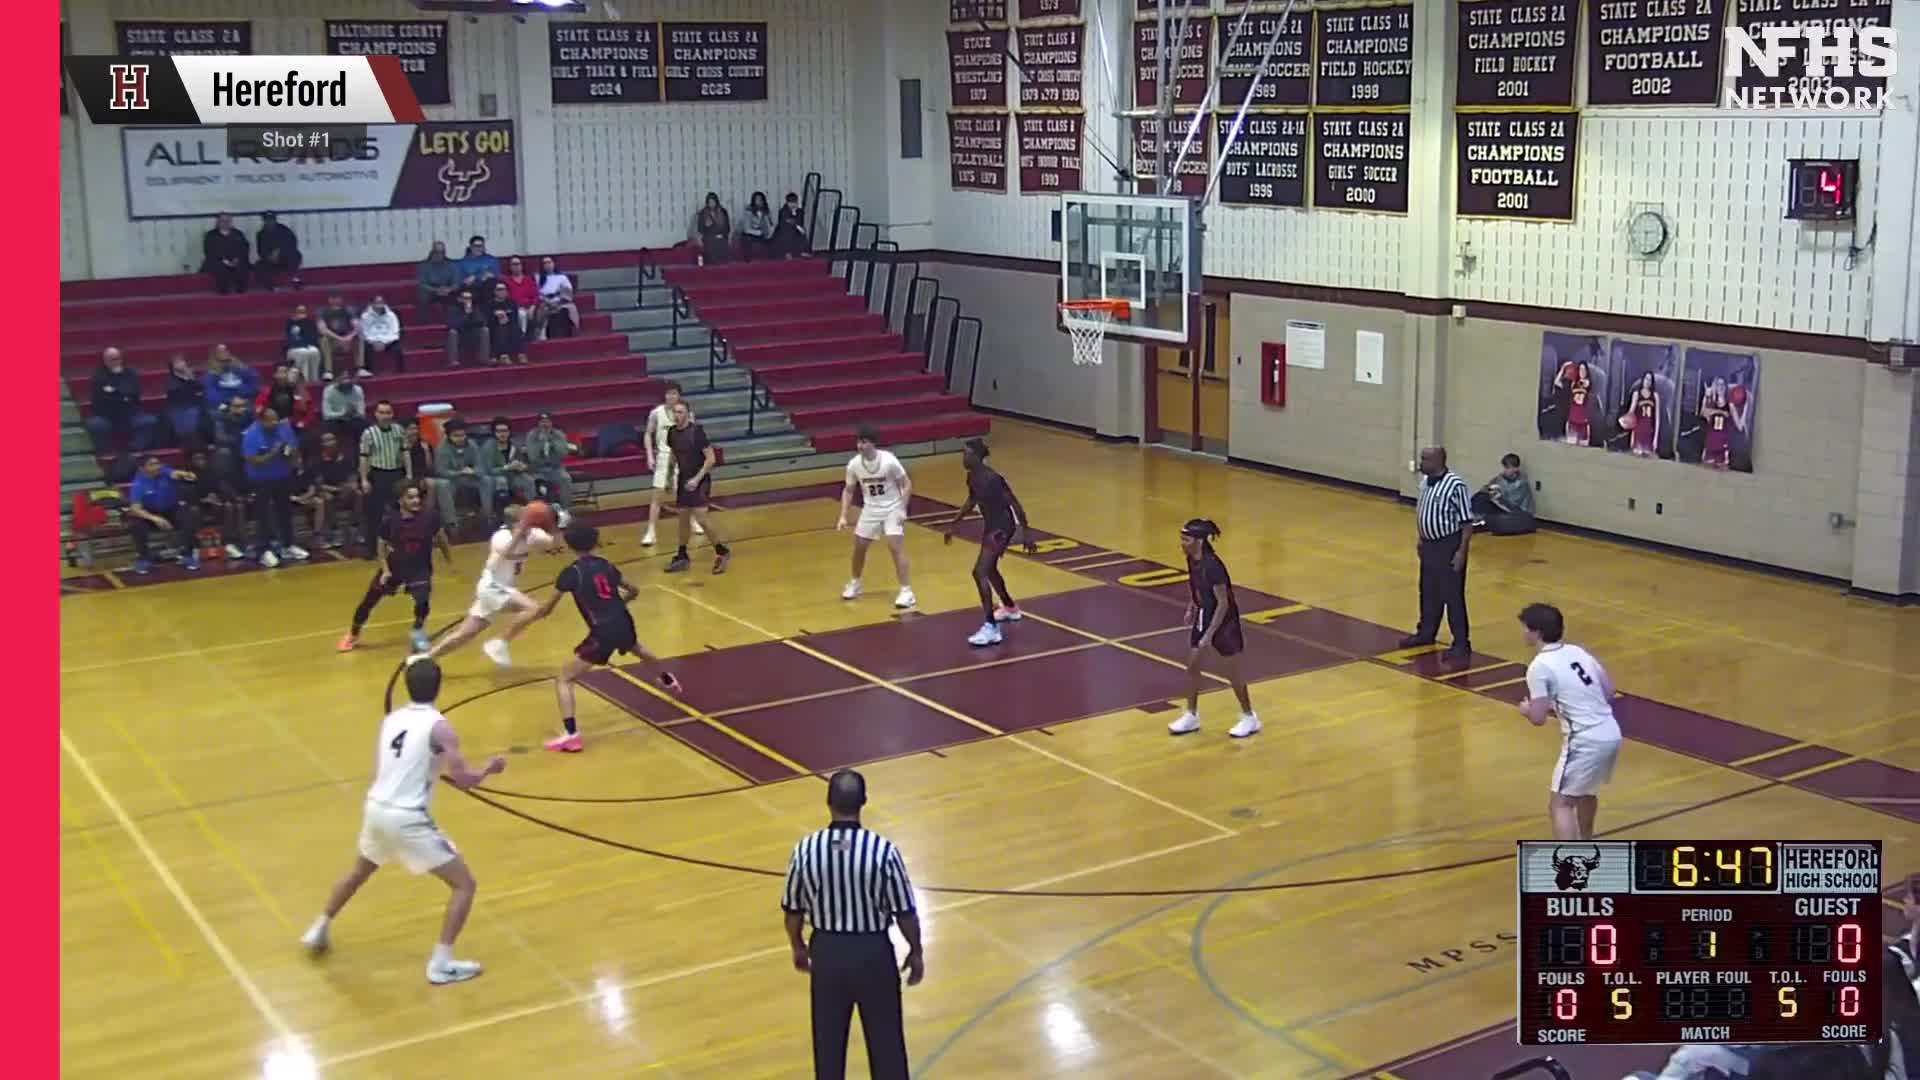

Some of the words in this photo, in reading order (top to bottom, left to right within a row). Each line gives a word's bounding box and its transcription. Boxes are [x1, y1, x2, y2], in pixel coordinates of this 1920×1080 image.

[1470, 9, 1502, 25] STATE
[1511, 7, 1546, 23] CLASS
[1551, 5, 1565, 21] 2A
[1601, 2, 1637, 20] STATE
[1647, 0, 1685, 17] CLASS
[1696, 0, 1712, 15] 2A
[1291, 20, 1302, 34] 2A
[1327, 17, 1354, 33] STATE
[1361, 16, 1391, 31] CLASS
[1399, 13, 1408, 28] 1A
[557, 30, 589, 42] STATE
[597, 29, 629, 42] CLASS
[636, 30, 652, 42] 2A
[672, 31, 702, 43] STATE
[709, 31, 739, 43] CLASS
[746, 31, 758, 43] 2A
[1047, 32, 1068, 45] CLASS
[1468, 30, 1565, 49] CHAMPIONS
[1601, 24, 1710, 45] CHAMPIONS
[338, 42, 437, 55] CHAMPIONS
[964, 37, 991, 49] STATE
[1327, 38, 1408, 54] CHAMPIONS
[560, 48, 648, 60] CHAMPIONS
[674, 49, 757, 60] CHAMPIONS
[954, 53, 1002, 66] CHAMPIONS
[1024, 51, 1077, 65] CHAMPIONS
[1605, 51, 1703, 70] FOOTBALL
[586, 66, 616, 78] TRACK
[1321, 61, 1356, 76] FIELD
[1363, 60, 1412, 76] HOCKEY
[1475, 57, 1505, 73] FIELD
[1512, 56, 1556, 72] HOCKEY
[590, 83, 622, 95] 2024
[1352, 84, 1379, 99] 1998
[1497, 81, 1528, 96] 2001
[1632, 77, 1671, 95] 2002
[1047, 120, 1067, 132] CLASS
[1250, 121, 1277, 134] CLASS
[1323, 121, 1351, 136] STATE
[1358, 121, 1388, 136] CLASS
[1392, 122, 1403, 136] 2A
[1468, 121, 1500, 137] STATE
[1510, 121, 1546, 137] CLASS
[1550, 121, 1564, 136] 2A
[475, 129, 510, 153] GO!
[953, 136, 1001, 149] CHAMPIONS
[1023, 137, 1076, 151] CHAMPIONS
[1228, 141, 1298, 156] CHAMPIONS
[145, 141, 221, 166] ALL
[1323, 143, 1404, 160] CHAMPIONS
[1468, 144, 1565, 162] CHAMPIONS
[1256, 162, 1297, 178] LACROSSE
[1364, 166, 1397, 182] SOCCER
[1471, 168, 1559, 186] FOOTBALL
[1249, 184, 1272, 198] 1996
[1820, 171, 1841, 204] 4
[1497, 193, 1528, 209] 2001
[869, 484, 885, 496] 22
[1570, 662, 1593, 686] 2
[391, 730, 407, 758] 4
